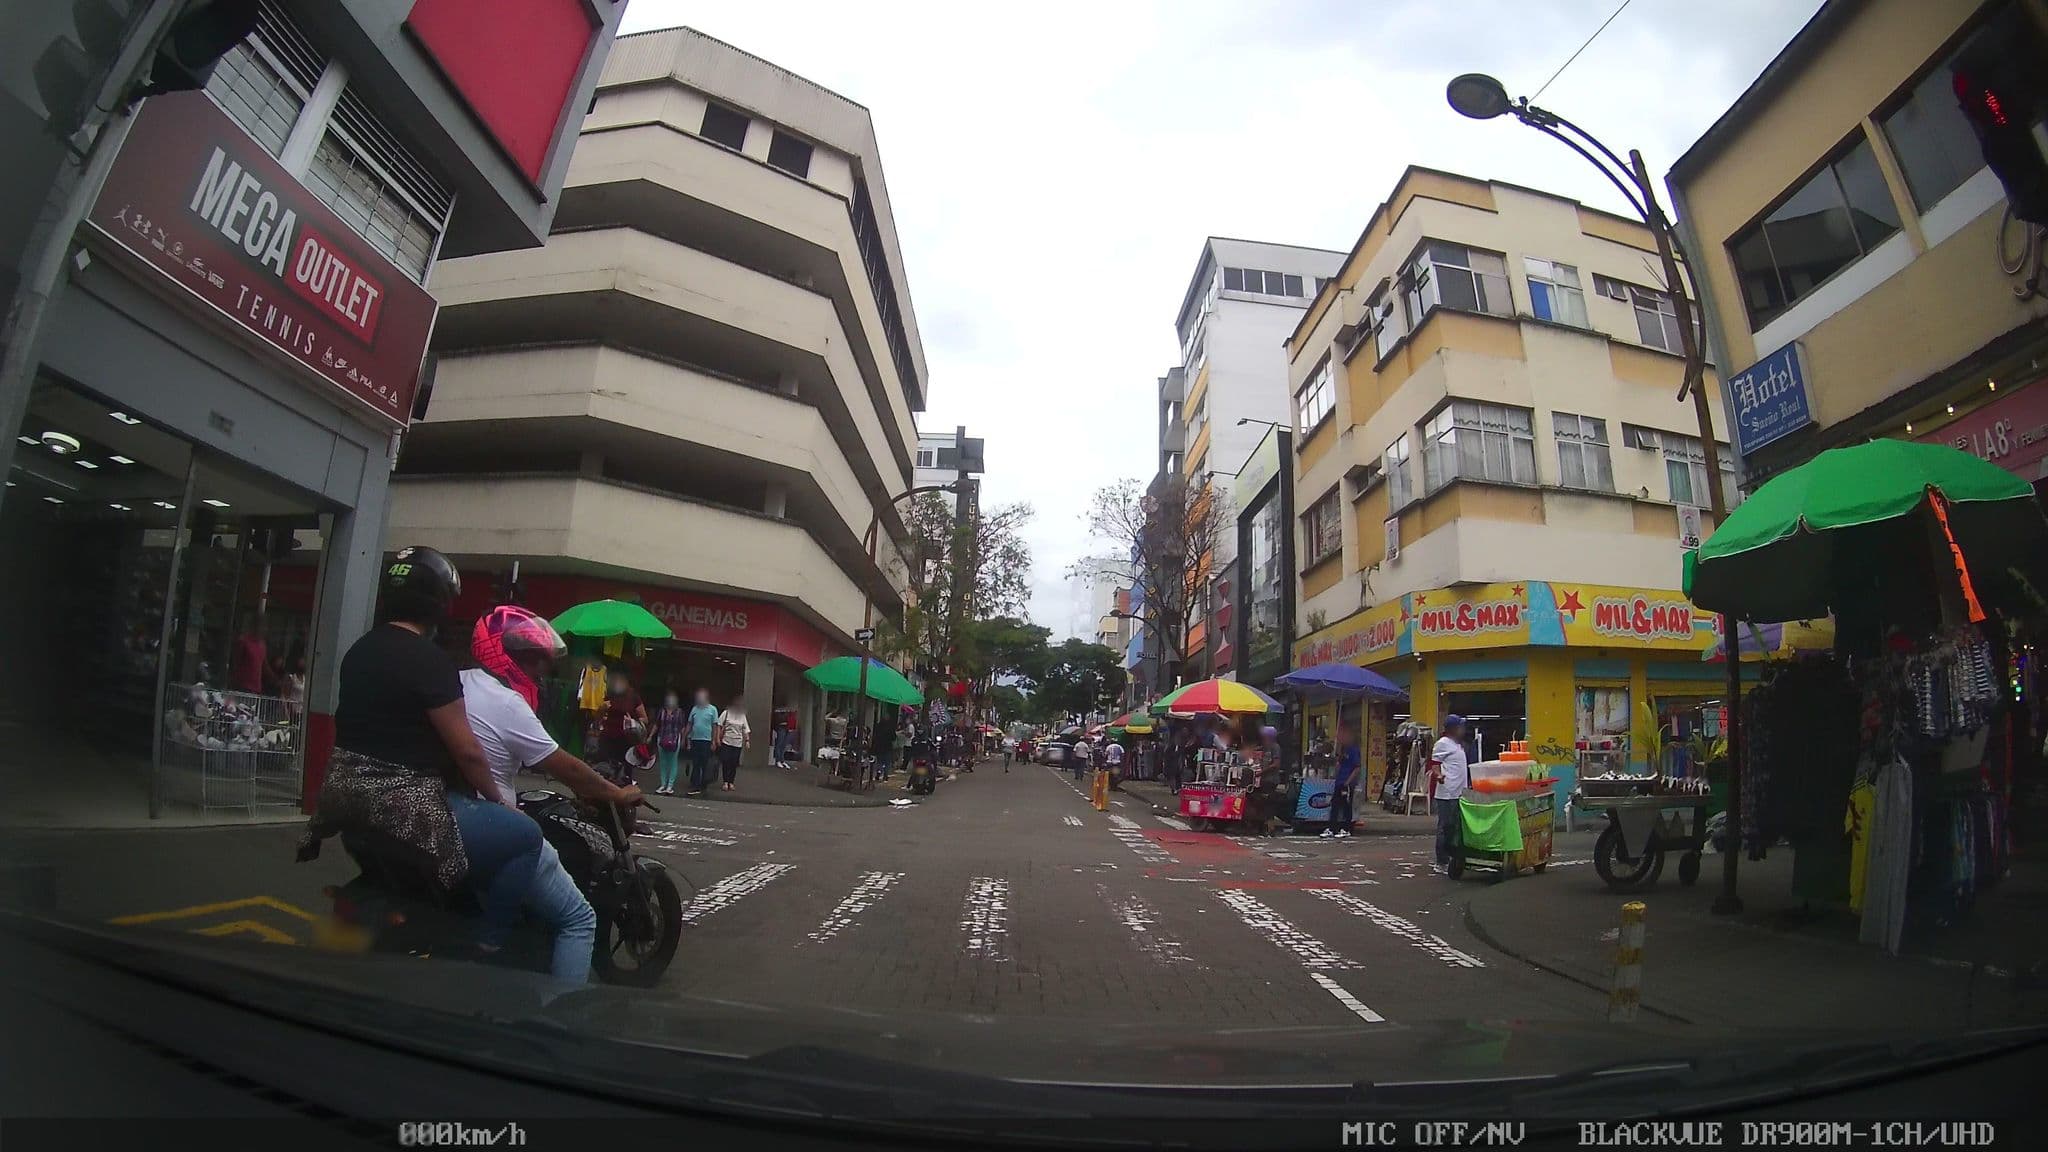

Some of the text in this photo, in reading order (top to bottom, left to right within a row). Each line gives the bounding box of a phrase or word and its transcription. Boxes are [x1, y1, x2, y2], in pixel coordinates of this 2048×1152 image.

[190, 146, 296, 277] MEGA
[296, 238, 378, 328] OUTLET
[236, 285, 315, 354] TENNIS
[1734, 351, 1796, 427] Hotel
[388, 563, 412, 575] 46
[650, 602, 748, 629] GANEMAS
